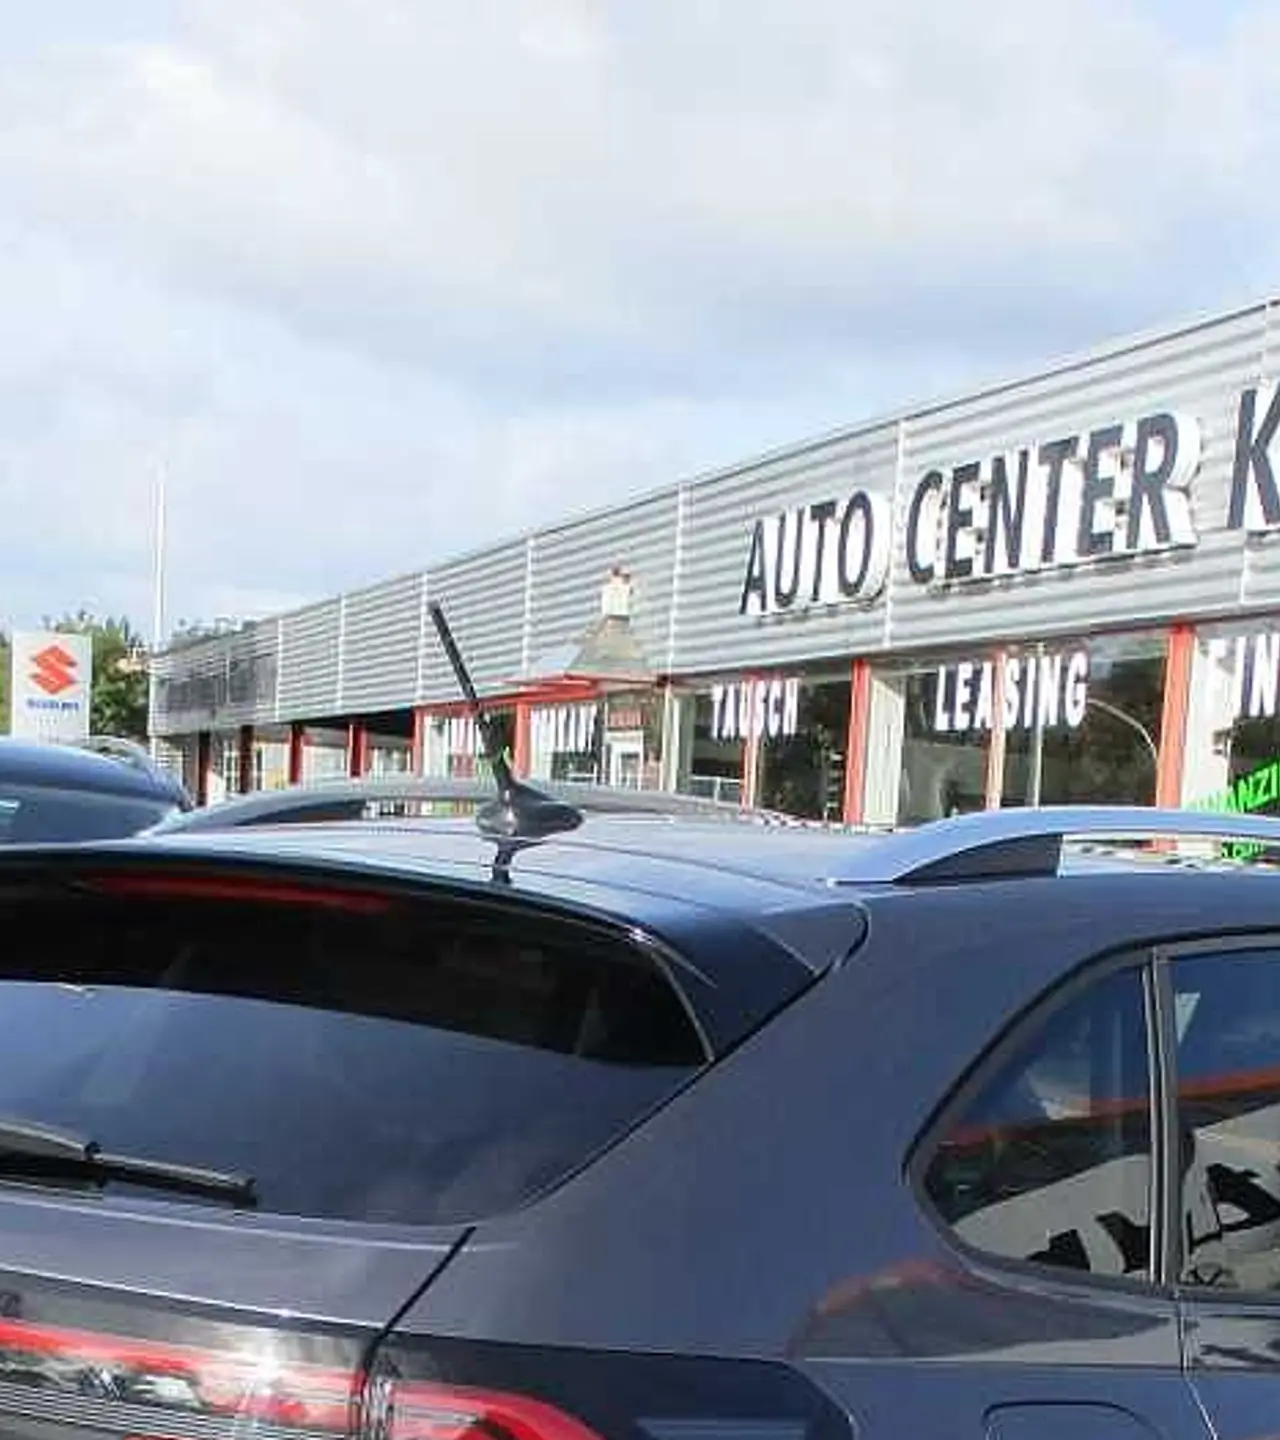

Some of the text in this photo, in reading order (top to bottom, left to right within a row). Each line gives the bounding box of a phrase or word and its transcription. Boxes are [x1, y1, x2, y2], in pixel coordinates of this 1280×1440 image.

[738, 489, 884, 615] AUTO
[906, 412, 1192, 583] CENTER
[711, 677, 799, 740] TAUSCH
[935, 652, 1089, 732] LEASING
